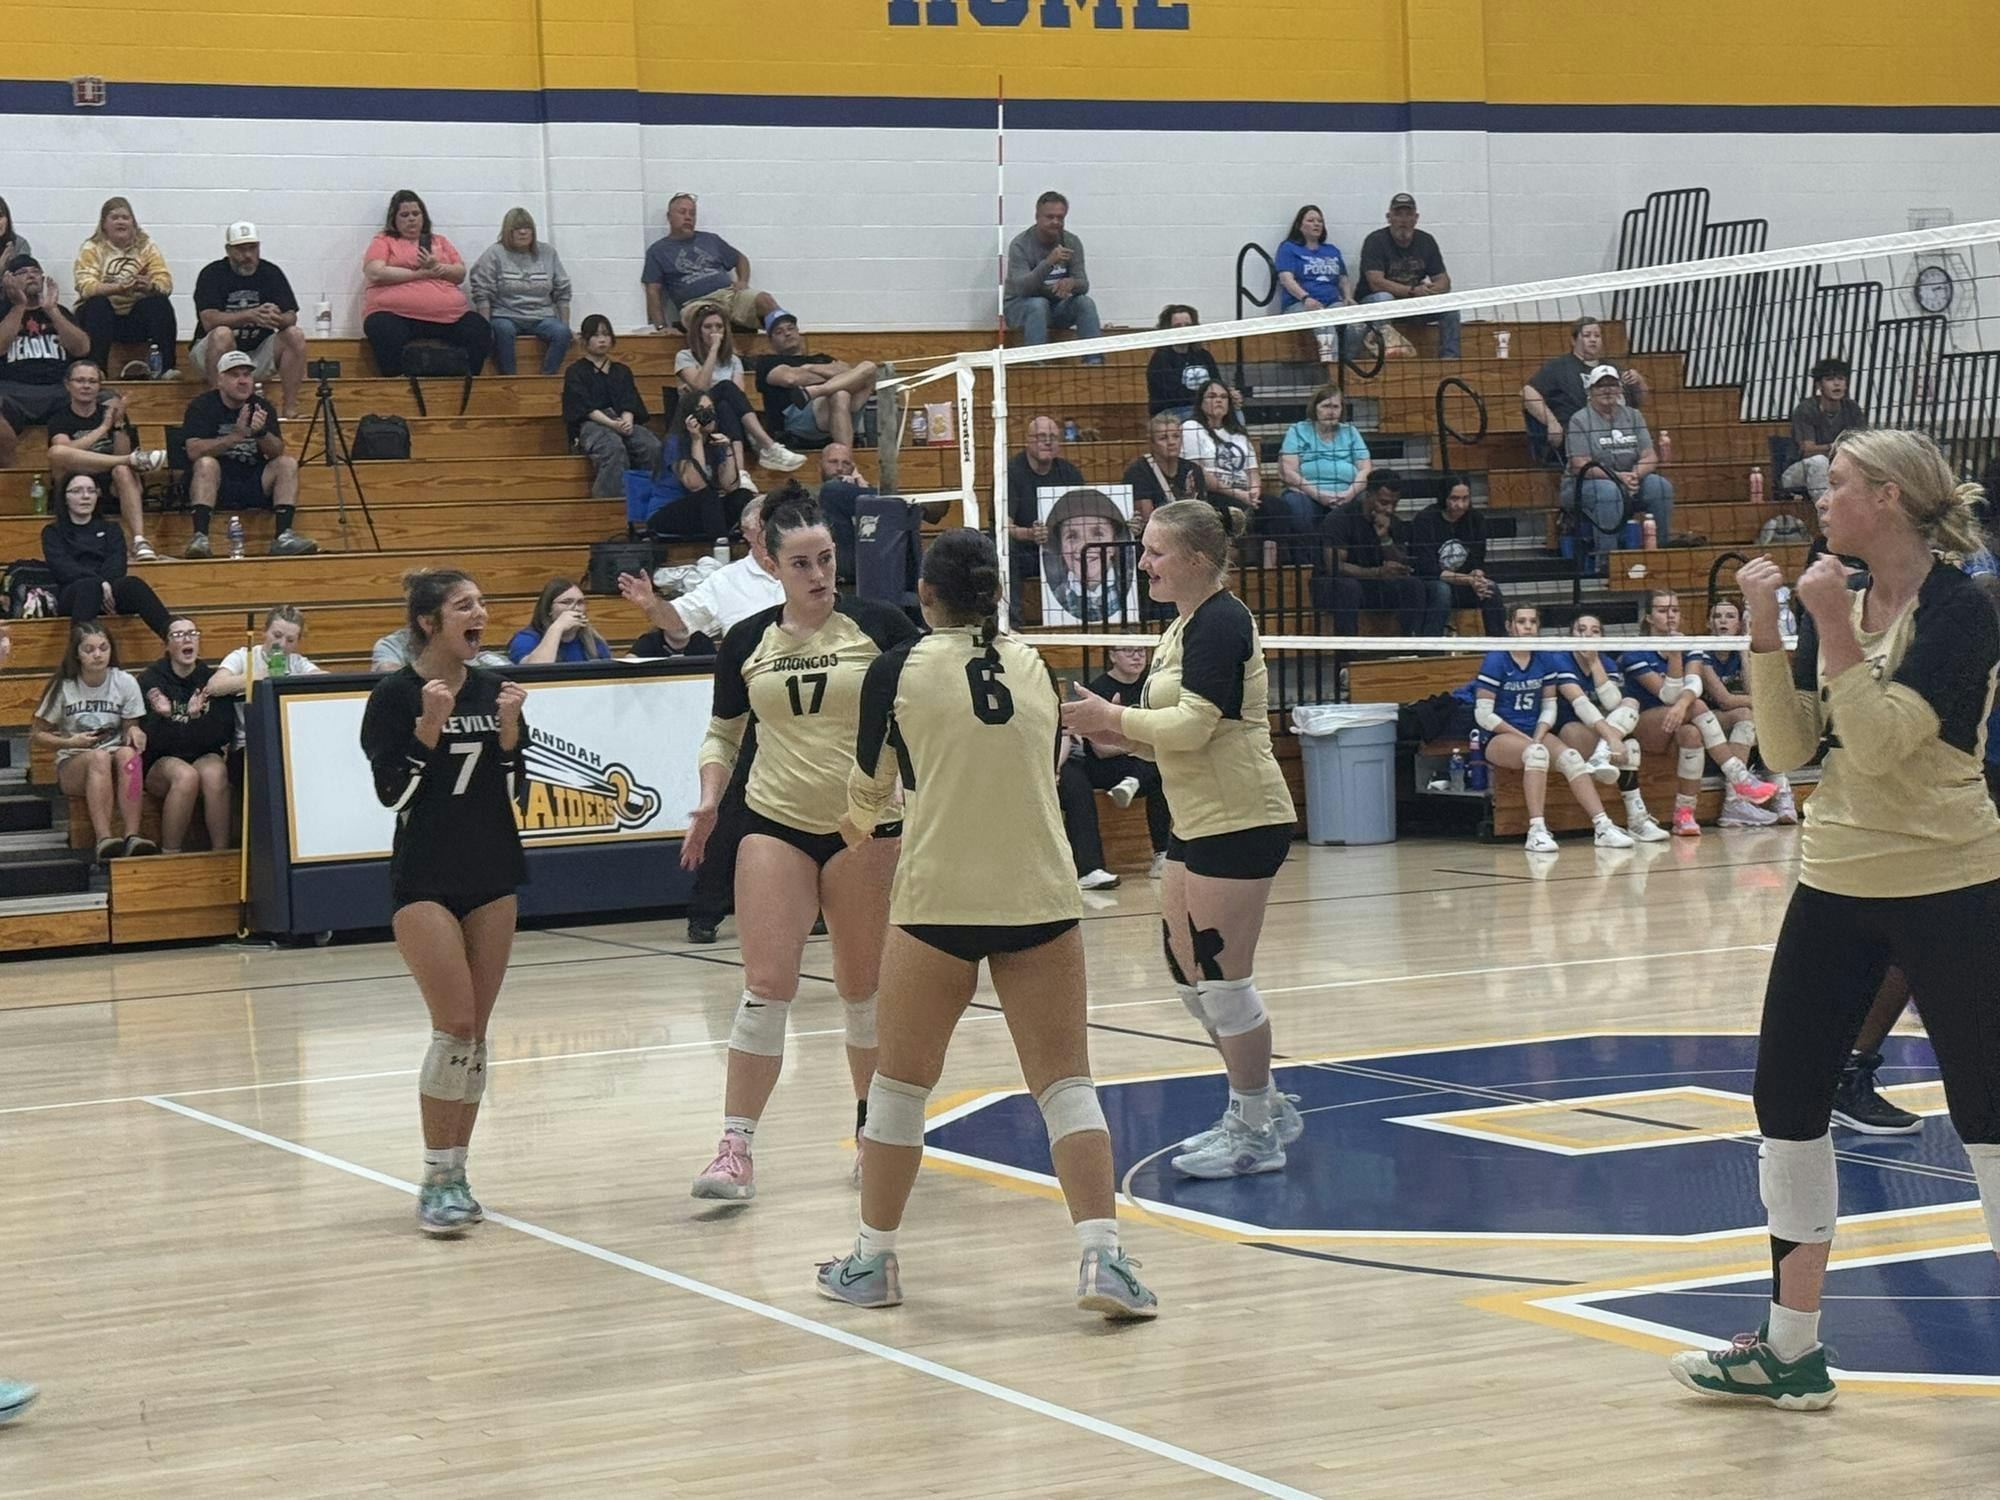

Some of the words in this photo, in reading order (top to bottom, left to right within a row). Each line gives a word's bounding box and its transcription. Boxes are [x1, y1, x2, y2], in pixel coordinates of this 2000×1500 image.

[785, 672, 828, 716] 17
[965, 657, 1015, 725] 6
[1514, 693, 1535, 711] 15
[449, 741, 483, 795] 7
